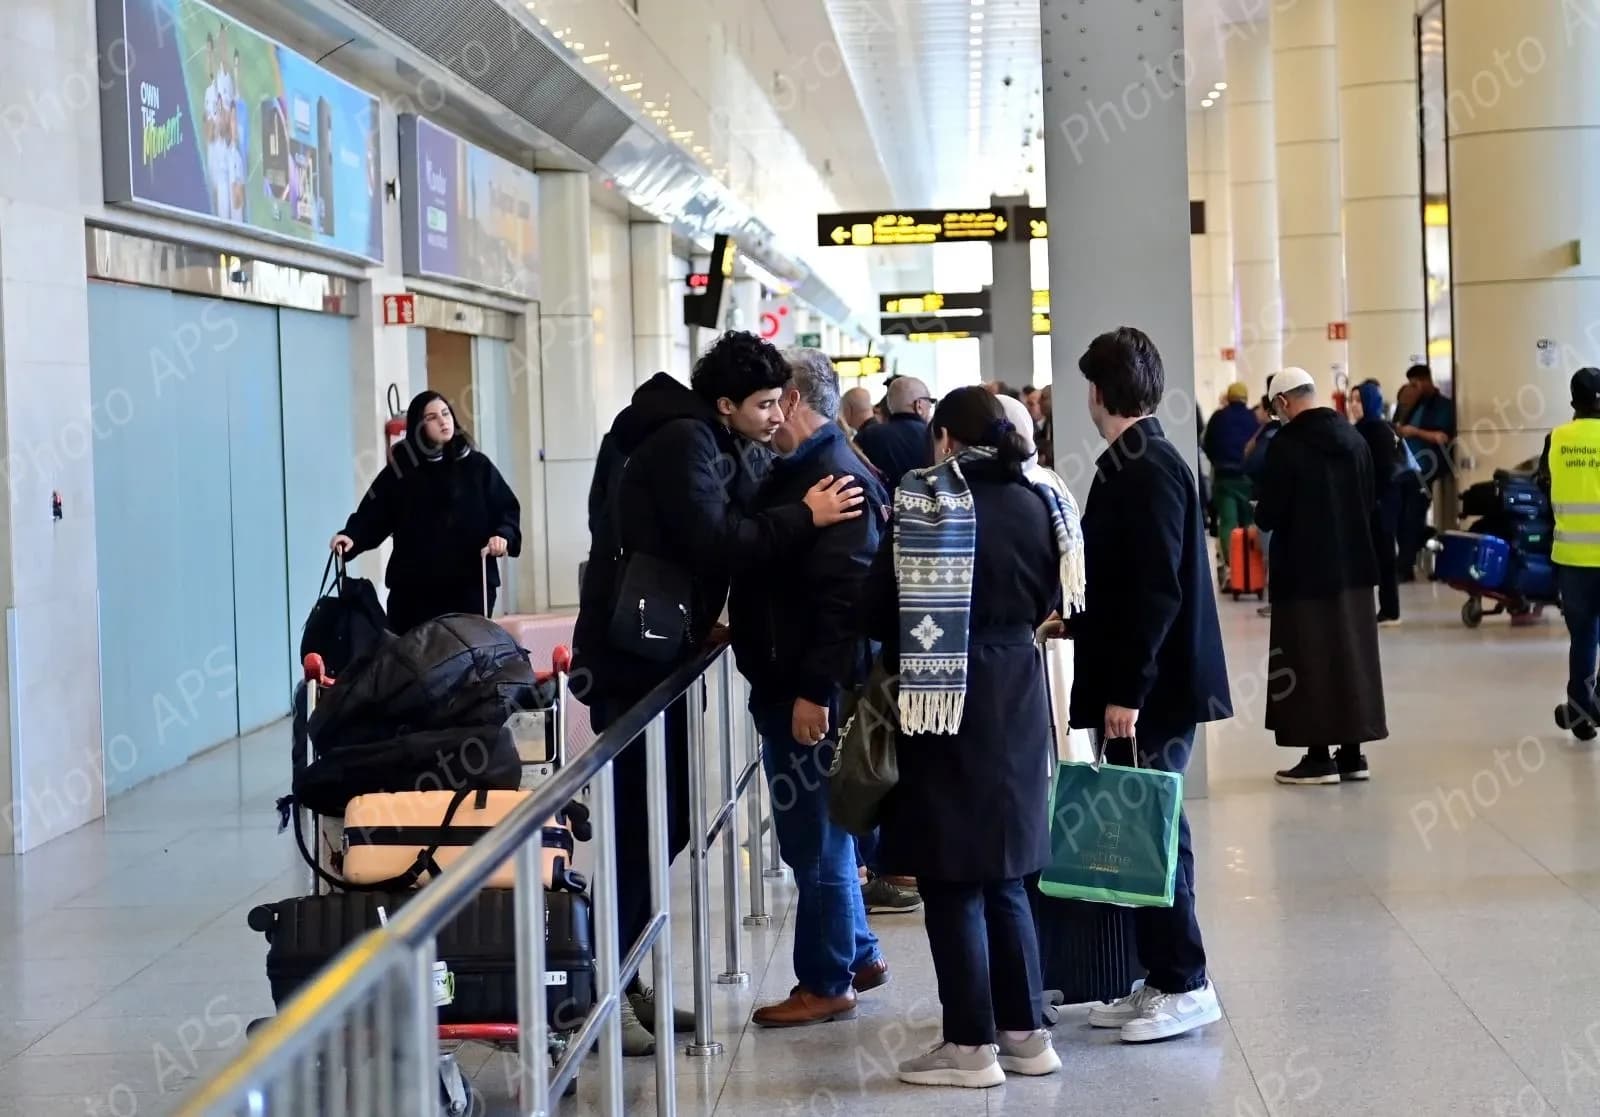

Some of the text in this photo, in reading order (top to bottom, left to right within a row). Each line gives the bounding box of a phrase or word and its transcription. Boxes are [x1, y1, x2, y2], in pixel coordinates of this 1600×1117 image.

[140, 81, 160, 109] OWN
[141, 105, 156, 129] THE
[1561, 444, 1597, 455] Divindus
